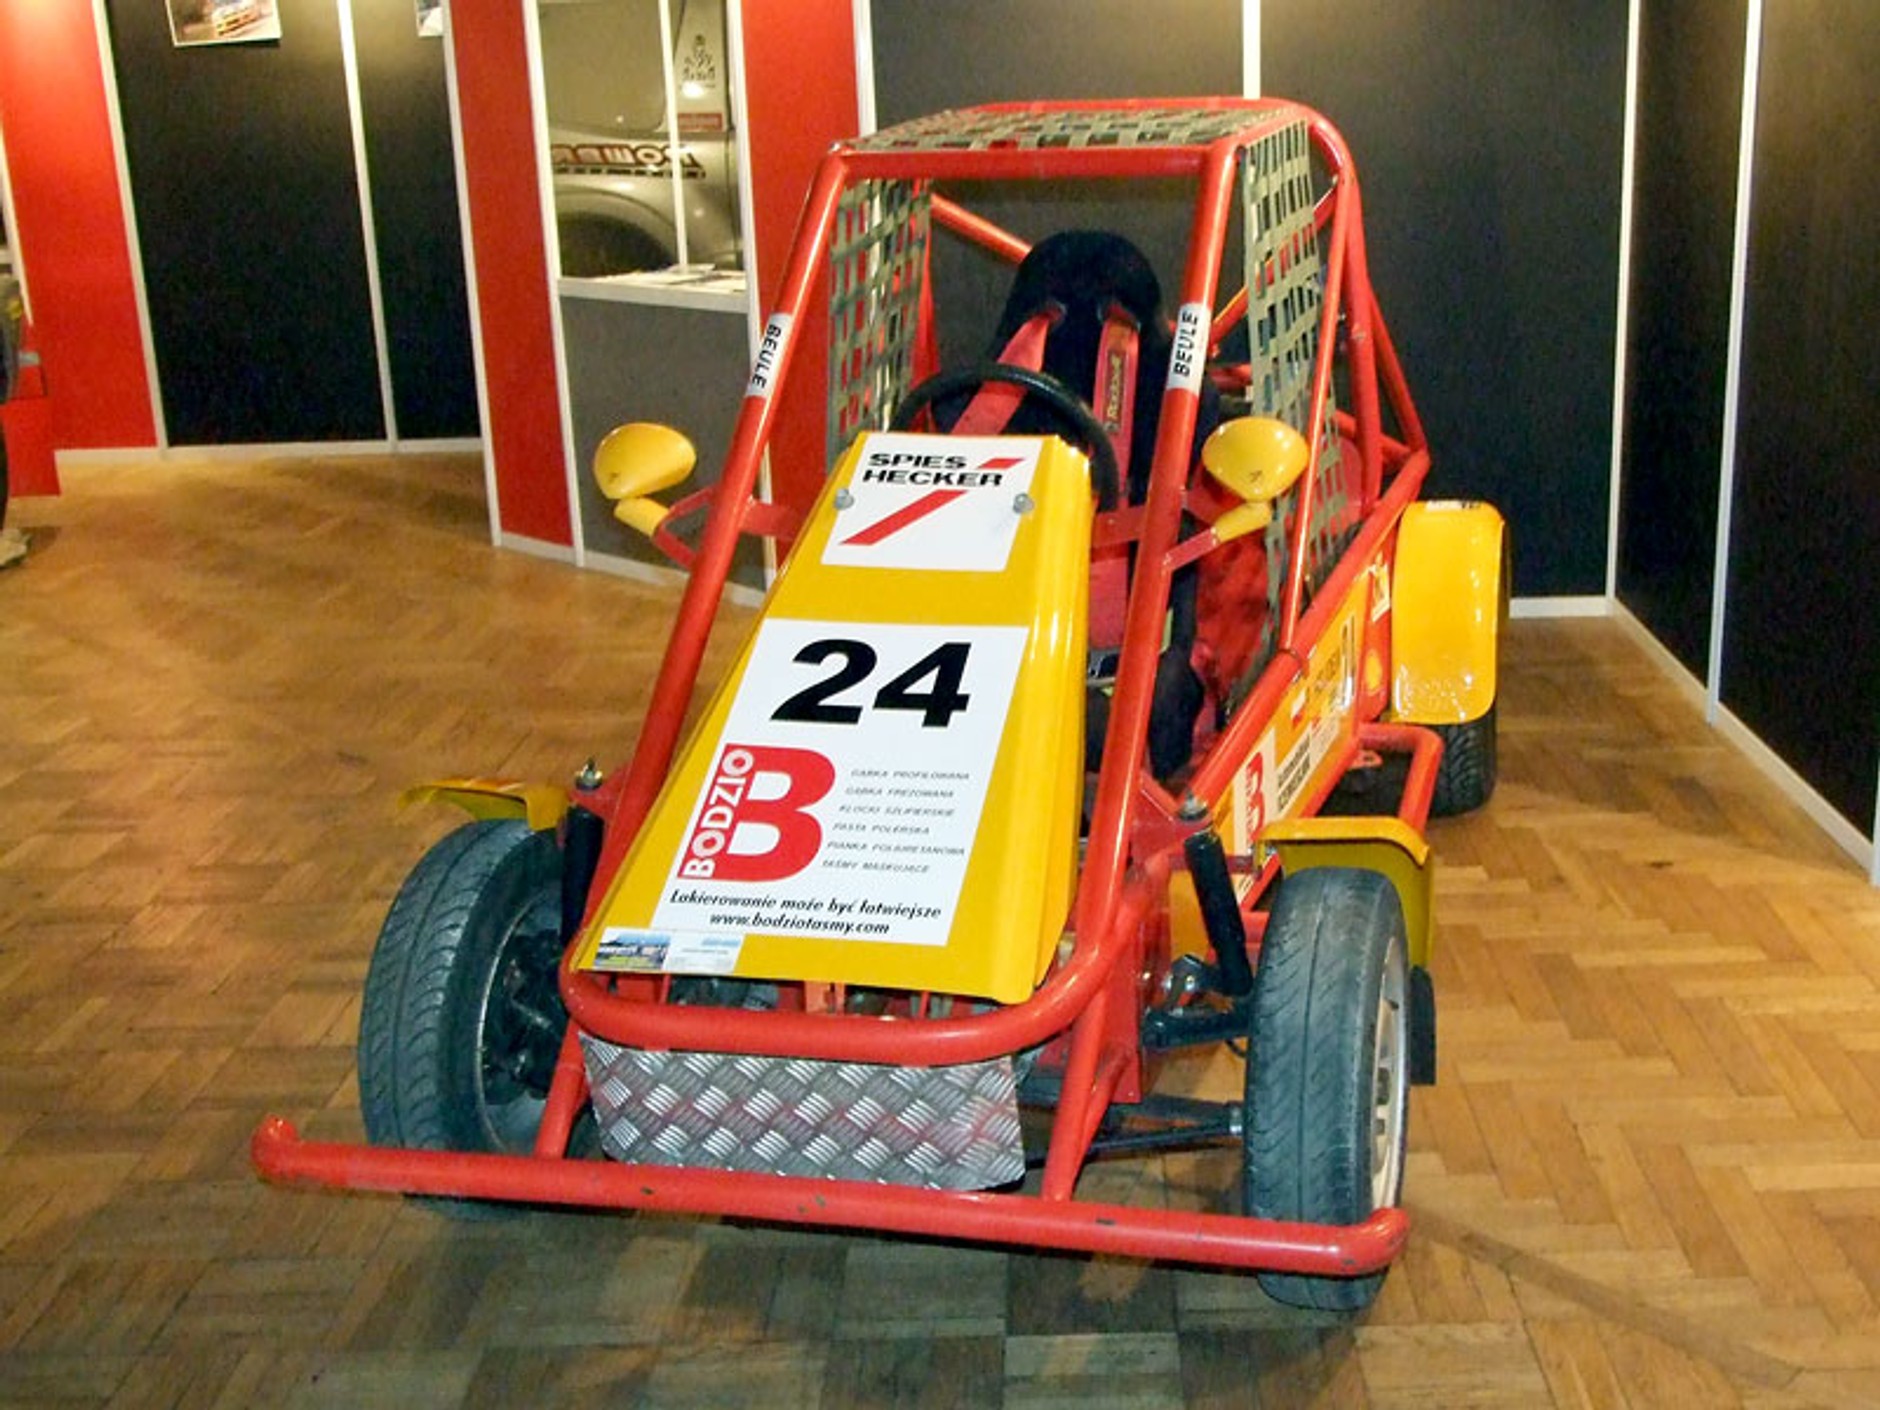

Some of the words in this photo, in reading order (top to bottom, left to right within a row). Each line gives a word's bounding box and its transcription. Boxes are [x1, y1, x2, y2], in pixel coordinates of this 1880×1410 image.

[749, 323, 783, 390] BEULE
[1172, 307, 1200, 378] BEULE
[869, 452, 967, 470] SPIES
[862, 469, 1004, 487] HECKER
[769, 638, 973, 729] 24
[677, 743, 836, 883] B
[683, 748, 755, 878] BODZIO
[832, 823, 867, 833] PASTA
[872, 824, 931, 836] POLERSKA
[827, 841, 868, 852] PIANKA
[670, 889, 776, 910] Lakierowanie
[781, 896, 824, 912] może
[828, 898, 856, 916] być
[860, 898, 942, 920] łatwiejsze
[709, 913, 890, 936] www.bodziotasmy.com
